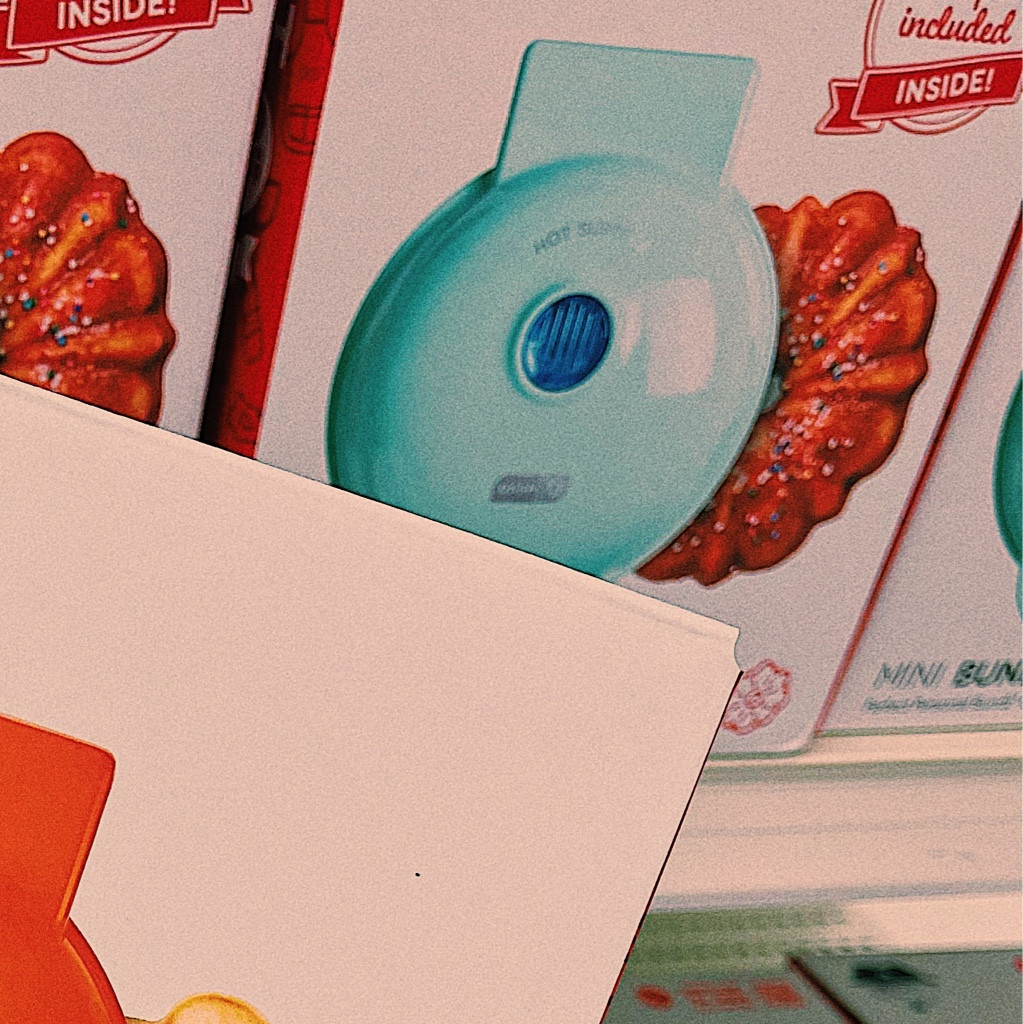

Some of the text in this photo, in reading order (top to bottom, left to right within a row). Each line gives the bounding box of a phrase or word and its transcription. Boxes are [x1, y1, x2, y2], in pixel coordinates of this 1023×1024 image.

[57, 0, 176, 30] INSIDE!
[898, 6, 1017, 44] included
[894, 68, 996, 105] INSIDE!
